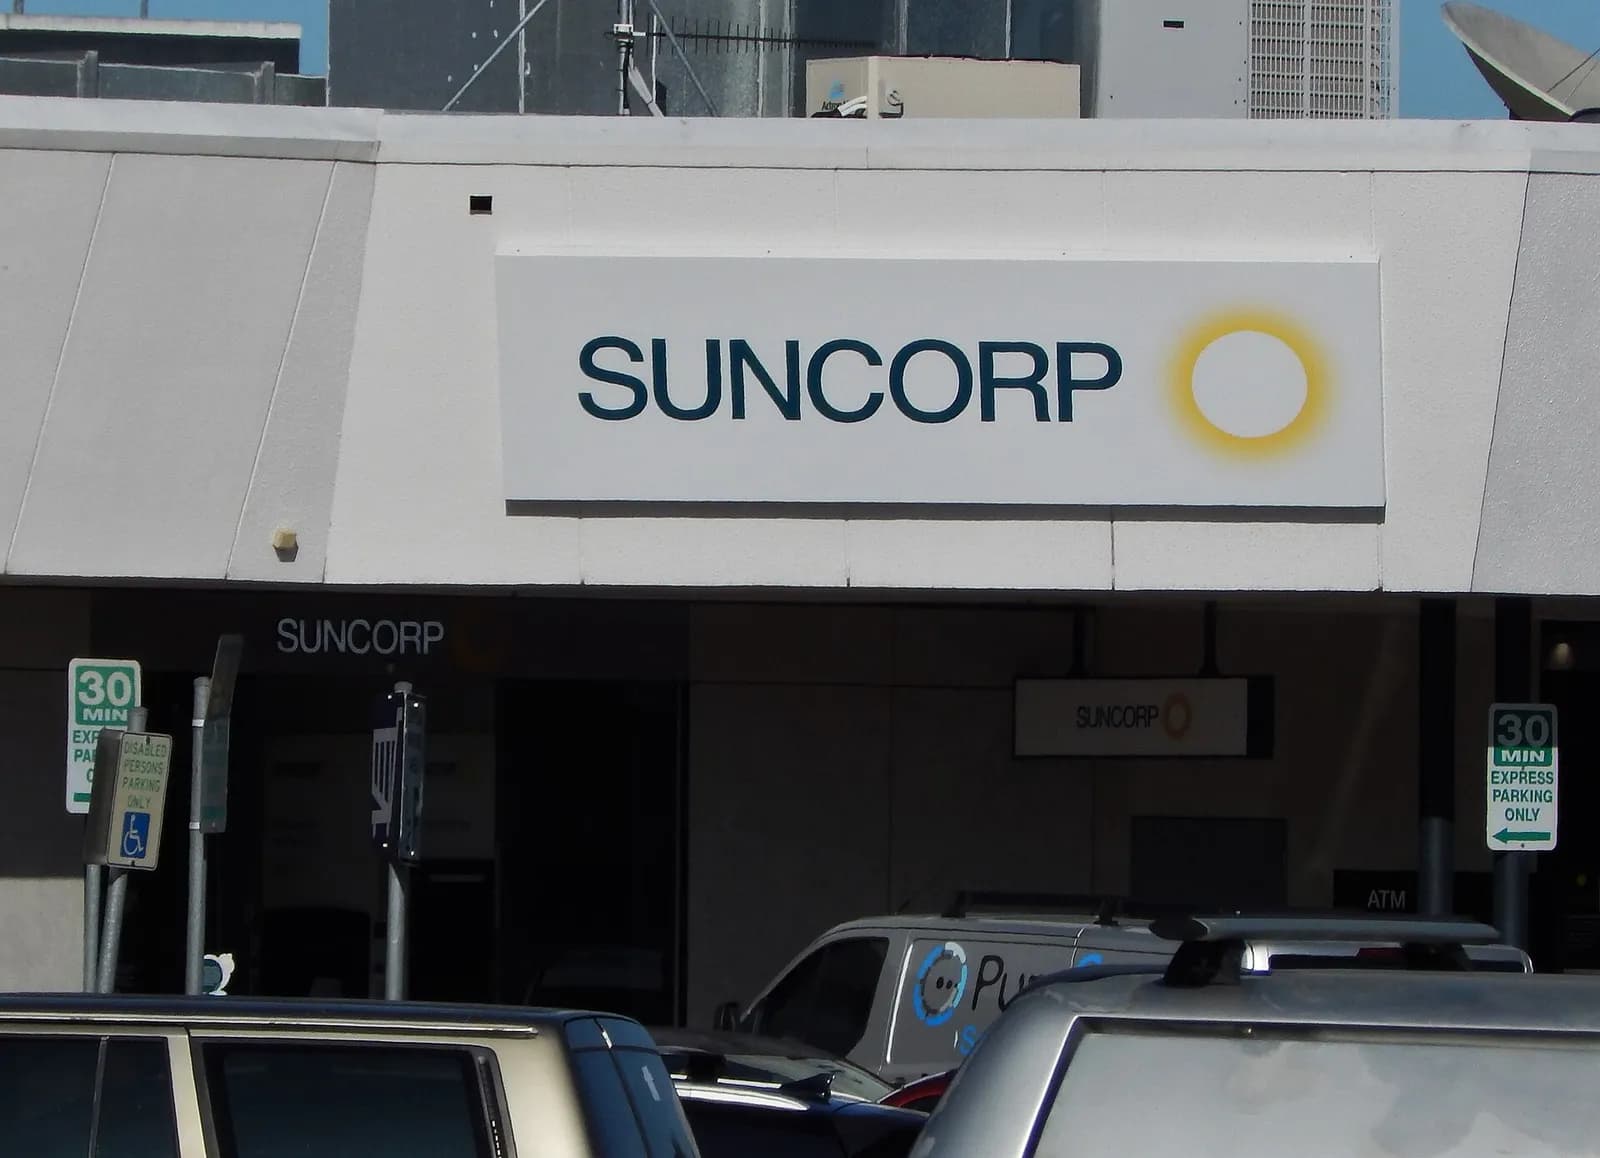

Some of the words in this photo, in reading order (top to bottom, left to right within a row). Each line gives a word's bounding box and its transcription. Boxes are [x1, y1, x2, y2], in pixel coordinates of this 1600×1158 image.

[578, 336, 1123, 424] SUNCORP
[277, 618, 445, 656] SUNCORP
[79, 671, 132, 707] 30
[83, 708, 129, 722] MIN
[1076, 706, 1160, 730] SUNCORP
[1497, 713, 1550, 746] 30
[1501, 750, 1545, 763] MIN
[121, 777, 161, 793] PARKING
[1491, 771, 1554, 785] EXPRESS
[1492, 789, 1553, 803] PARKING
[1504, 808, 1541, 822] ONLY
[1367, 889, 1406, 909] ATM
